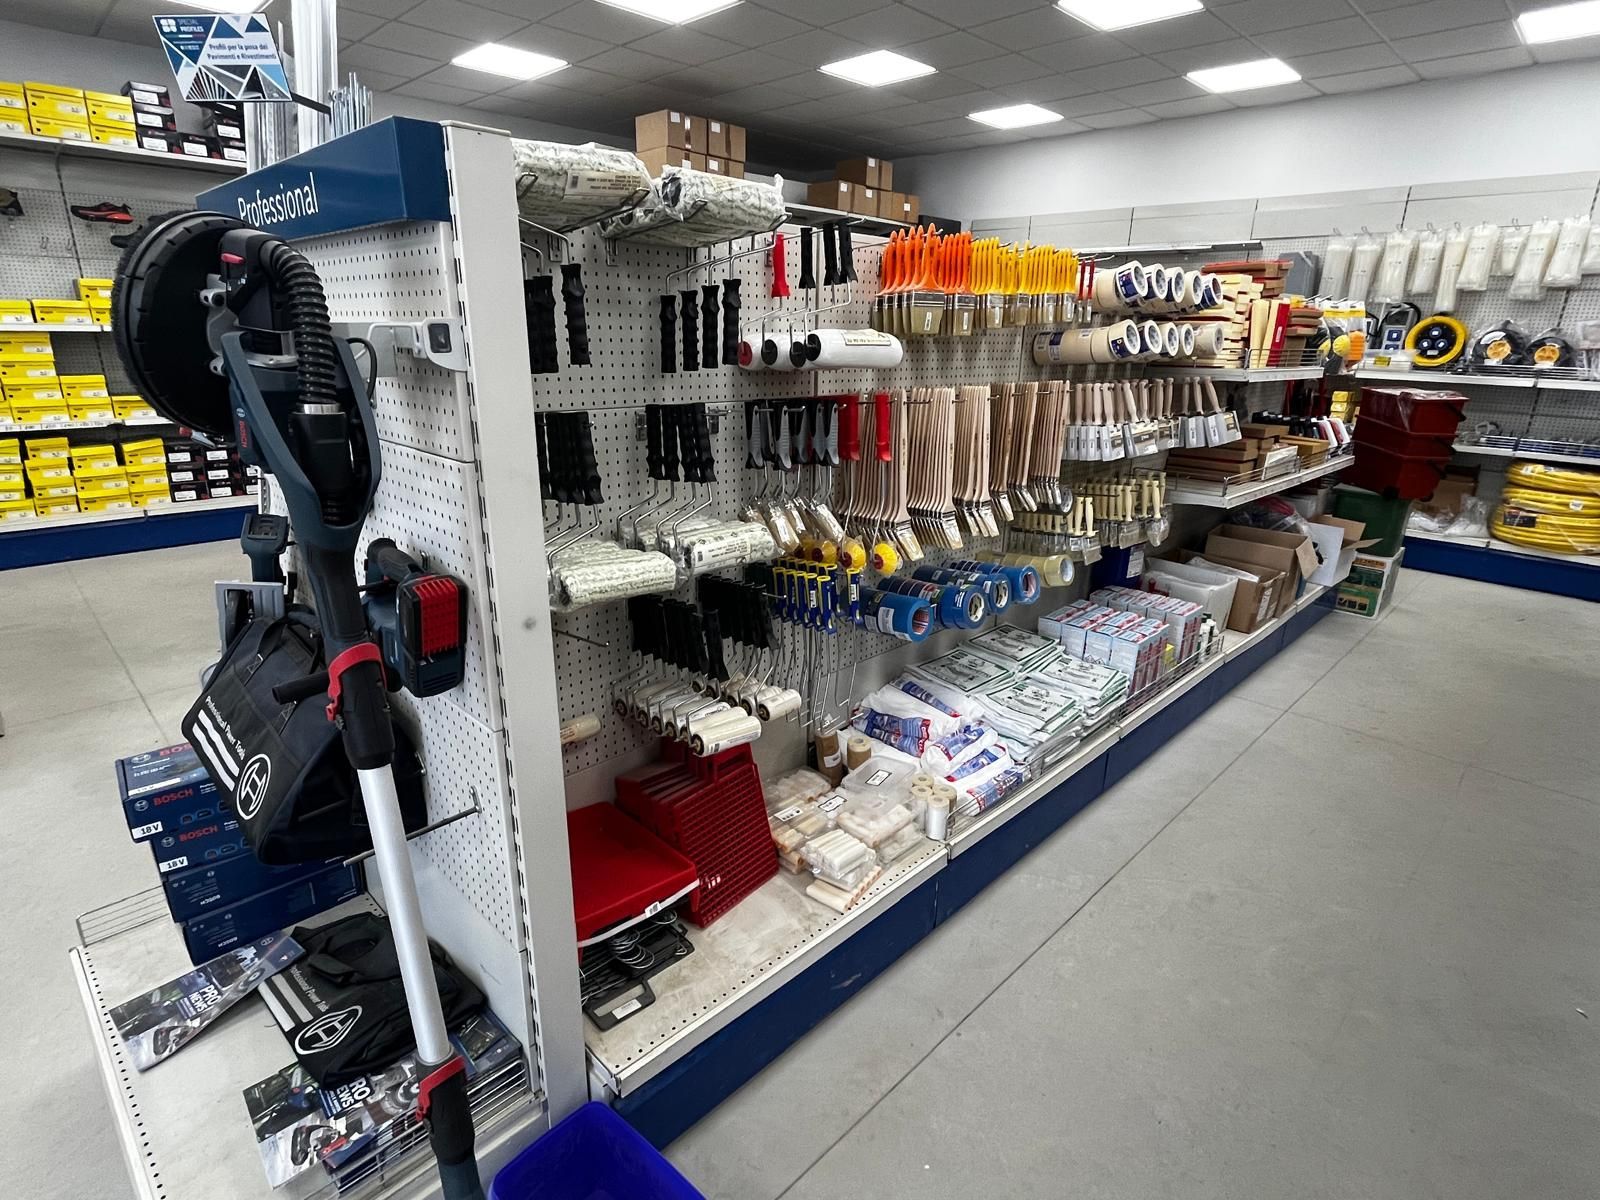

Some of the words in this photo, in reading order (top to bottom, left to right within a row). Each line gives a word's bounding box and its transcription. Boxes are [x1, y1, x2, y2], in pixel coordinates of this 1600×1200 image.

[237, 171, 319, 228] Professional
[160, 743, 193, 756] BOS
[154, 789, 193, 806] BOSCH
[179, 826, 218, 841] BOSCH
[188, 991, 208, 1012] NEWS
[199, 984, 222, 1006] PRO
[336, 1085, 355, 1108] EWS
[349, 1077, 371, 1101] RO
